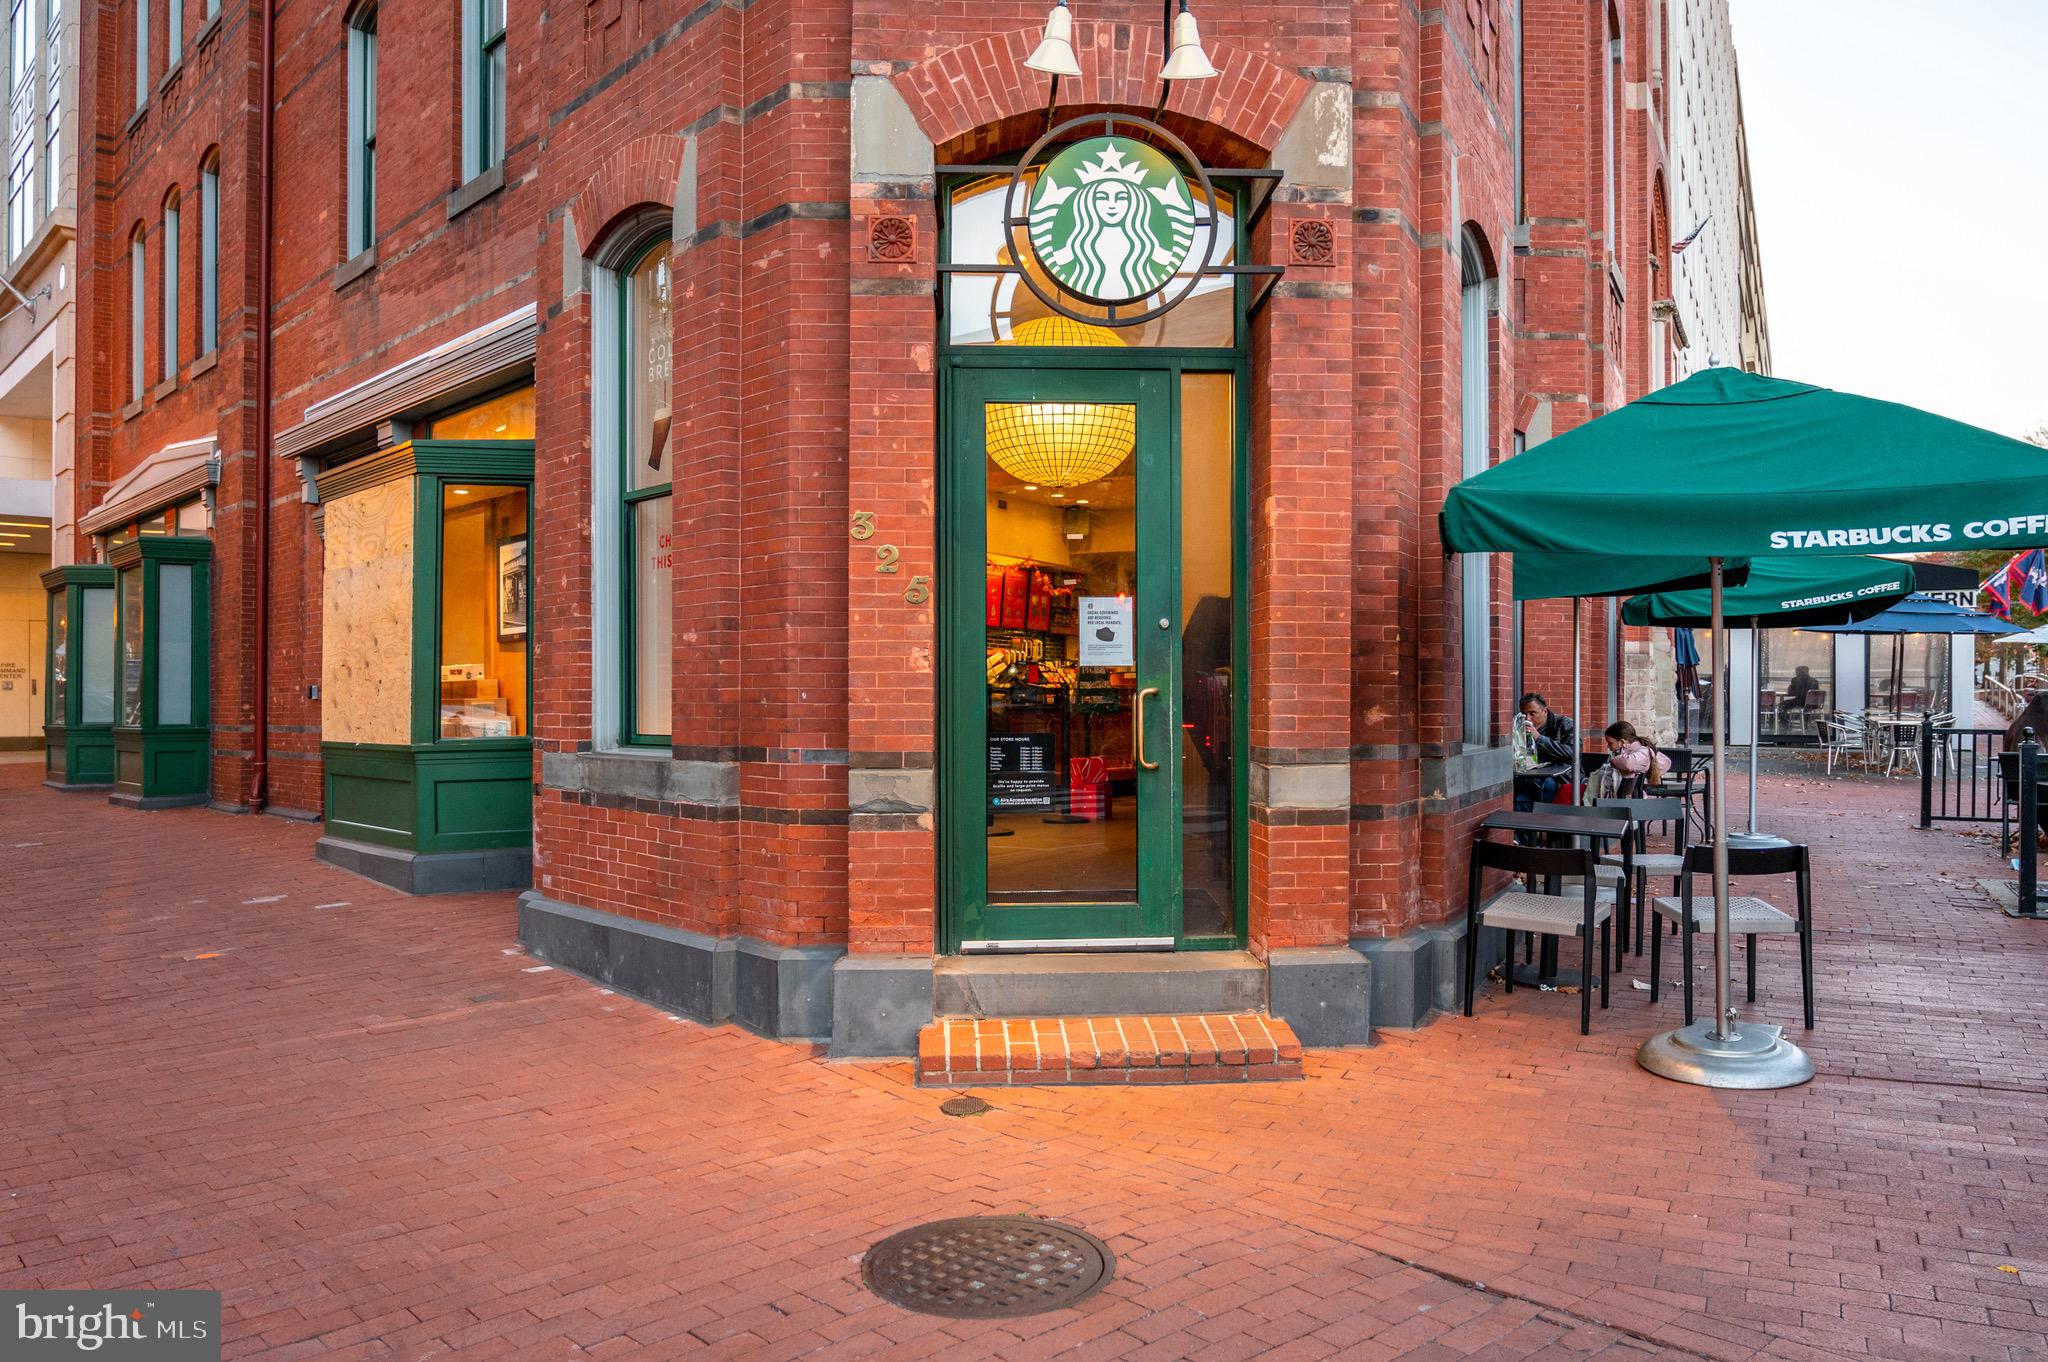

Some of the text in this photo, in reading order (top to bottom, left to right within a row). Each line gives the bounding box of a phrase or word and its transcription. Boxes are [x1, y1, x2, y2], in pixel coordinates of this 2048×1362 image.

[648, 361, 672, 382] BRE
[1770, 514, 2048, 549] STARBUCKS COFF
[651, 554, 672, 569] THIS
[1781, 582, 1900, 609] STARBUCKS COFFEE
[1924, 591, 1974, 606] ERN
